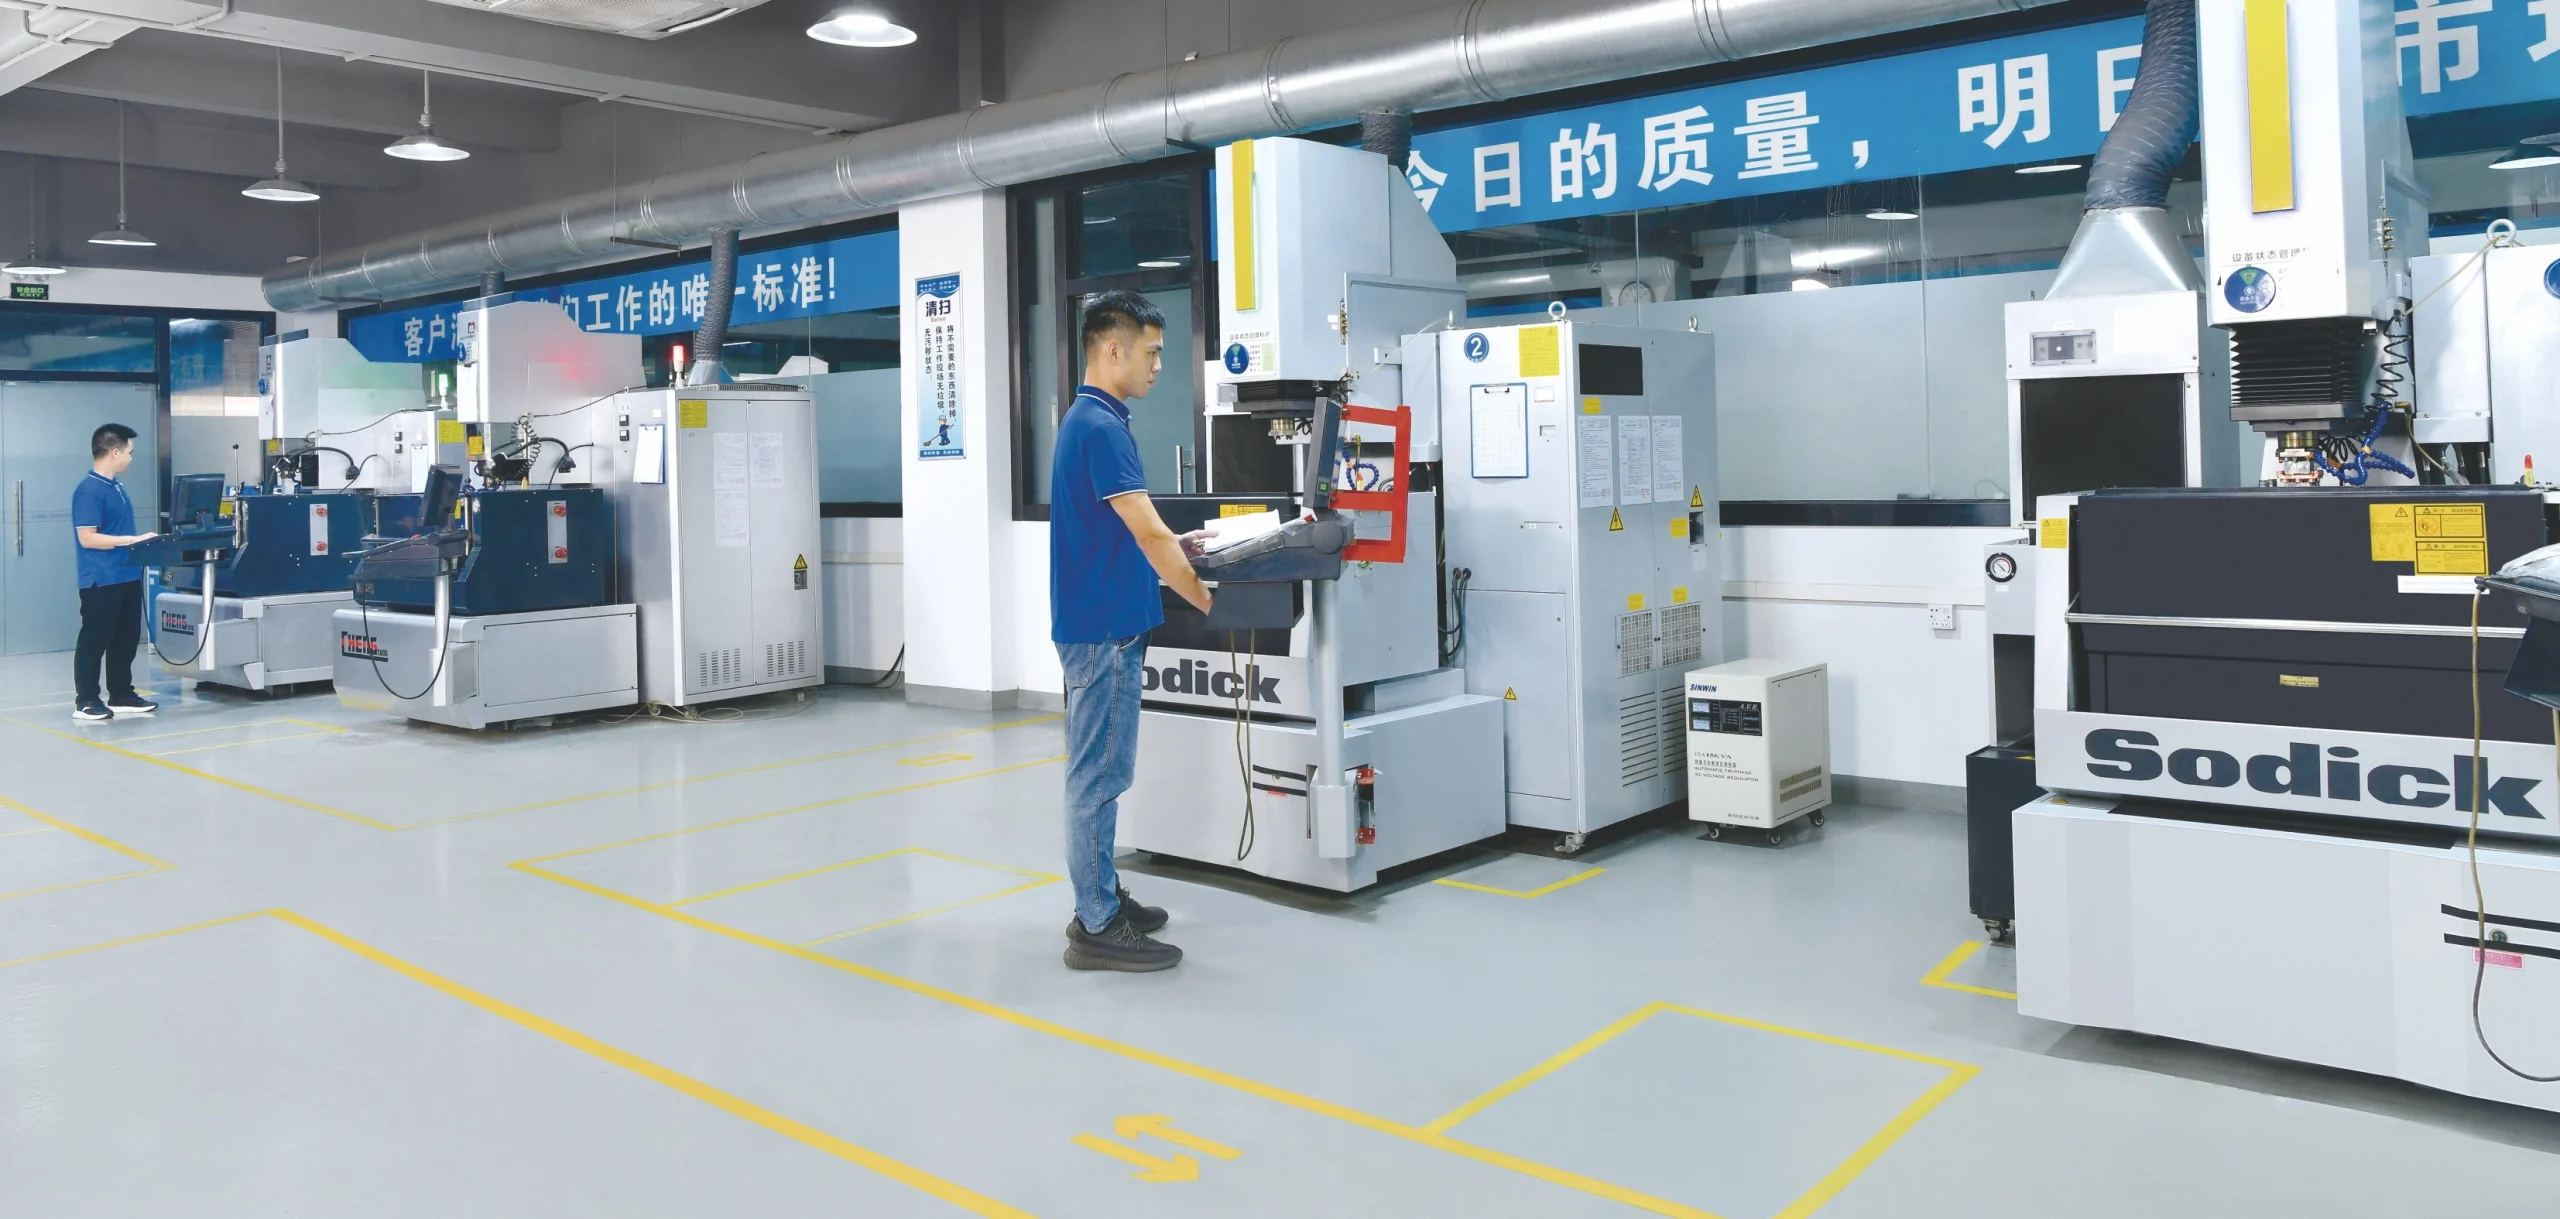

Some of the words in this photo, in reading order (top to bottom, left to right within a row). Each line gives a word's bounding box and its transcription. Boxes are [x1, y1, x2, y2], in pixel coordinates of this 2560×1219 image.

[926, 300, 951, 317] 清扫
[1470, 337, 1483, 357] 2
[1142, 658, 1282, 704] odick
[1689, 683, 1718, 693] SINWIN
[2084, 727, 2547, 821] Sodick
